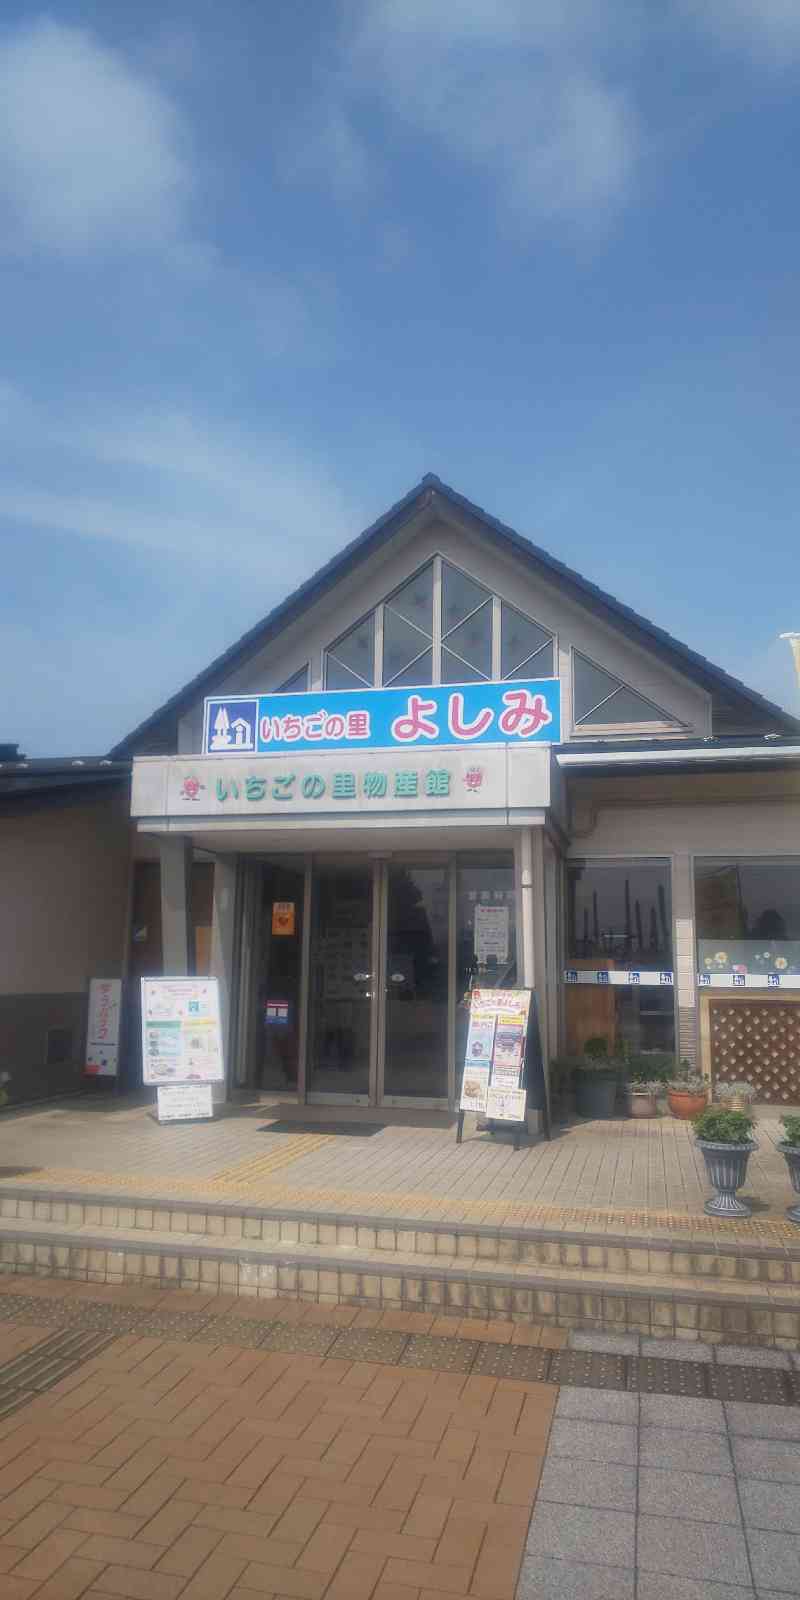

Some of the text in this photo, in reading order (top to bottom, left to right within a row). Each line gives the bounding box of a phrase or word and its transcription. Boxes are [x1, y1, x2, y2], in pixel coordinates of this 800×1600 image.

[260, 689, 551, 741] いちごの里 よしみ
[214, 768, 451, 802] いちごの里物産館
